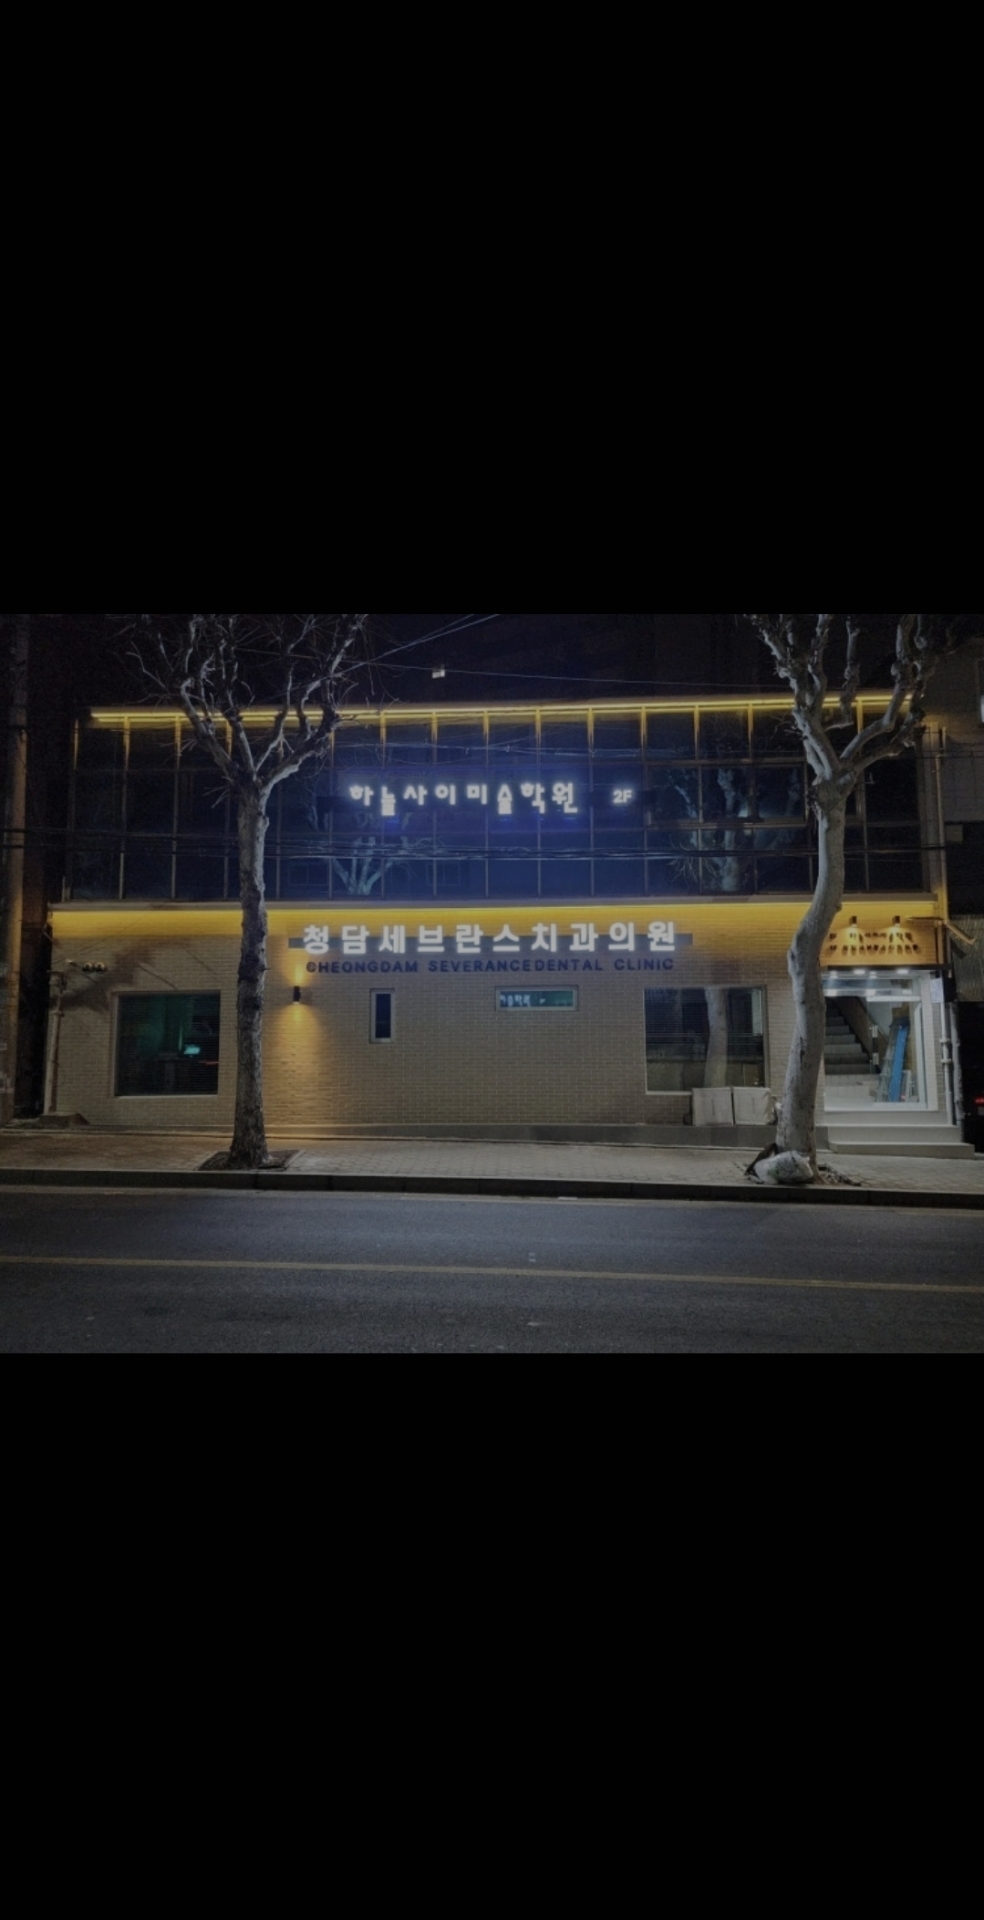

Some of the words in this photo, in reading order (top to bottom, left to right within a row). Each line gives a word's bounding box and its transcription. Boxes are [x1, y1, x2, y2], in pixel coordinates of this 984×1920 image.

[349, 783, 578, 816] 하늘사이미술학원
[612, 789, 633, 804] 2F
[302, 921, 677, 955] 청담세브란스치과의원
[305, 961, 419, 974] CHEONGDAM
[613, 958, 674, 972] CLINIC
